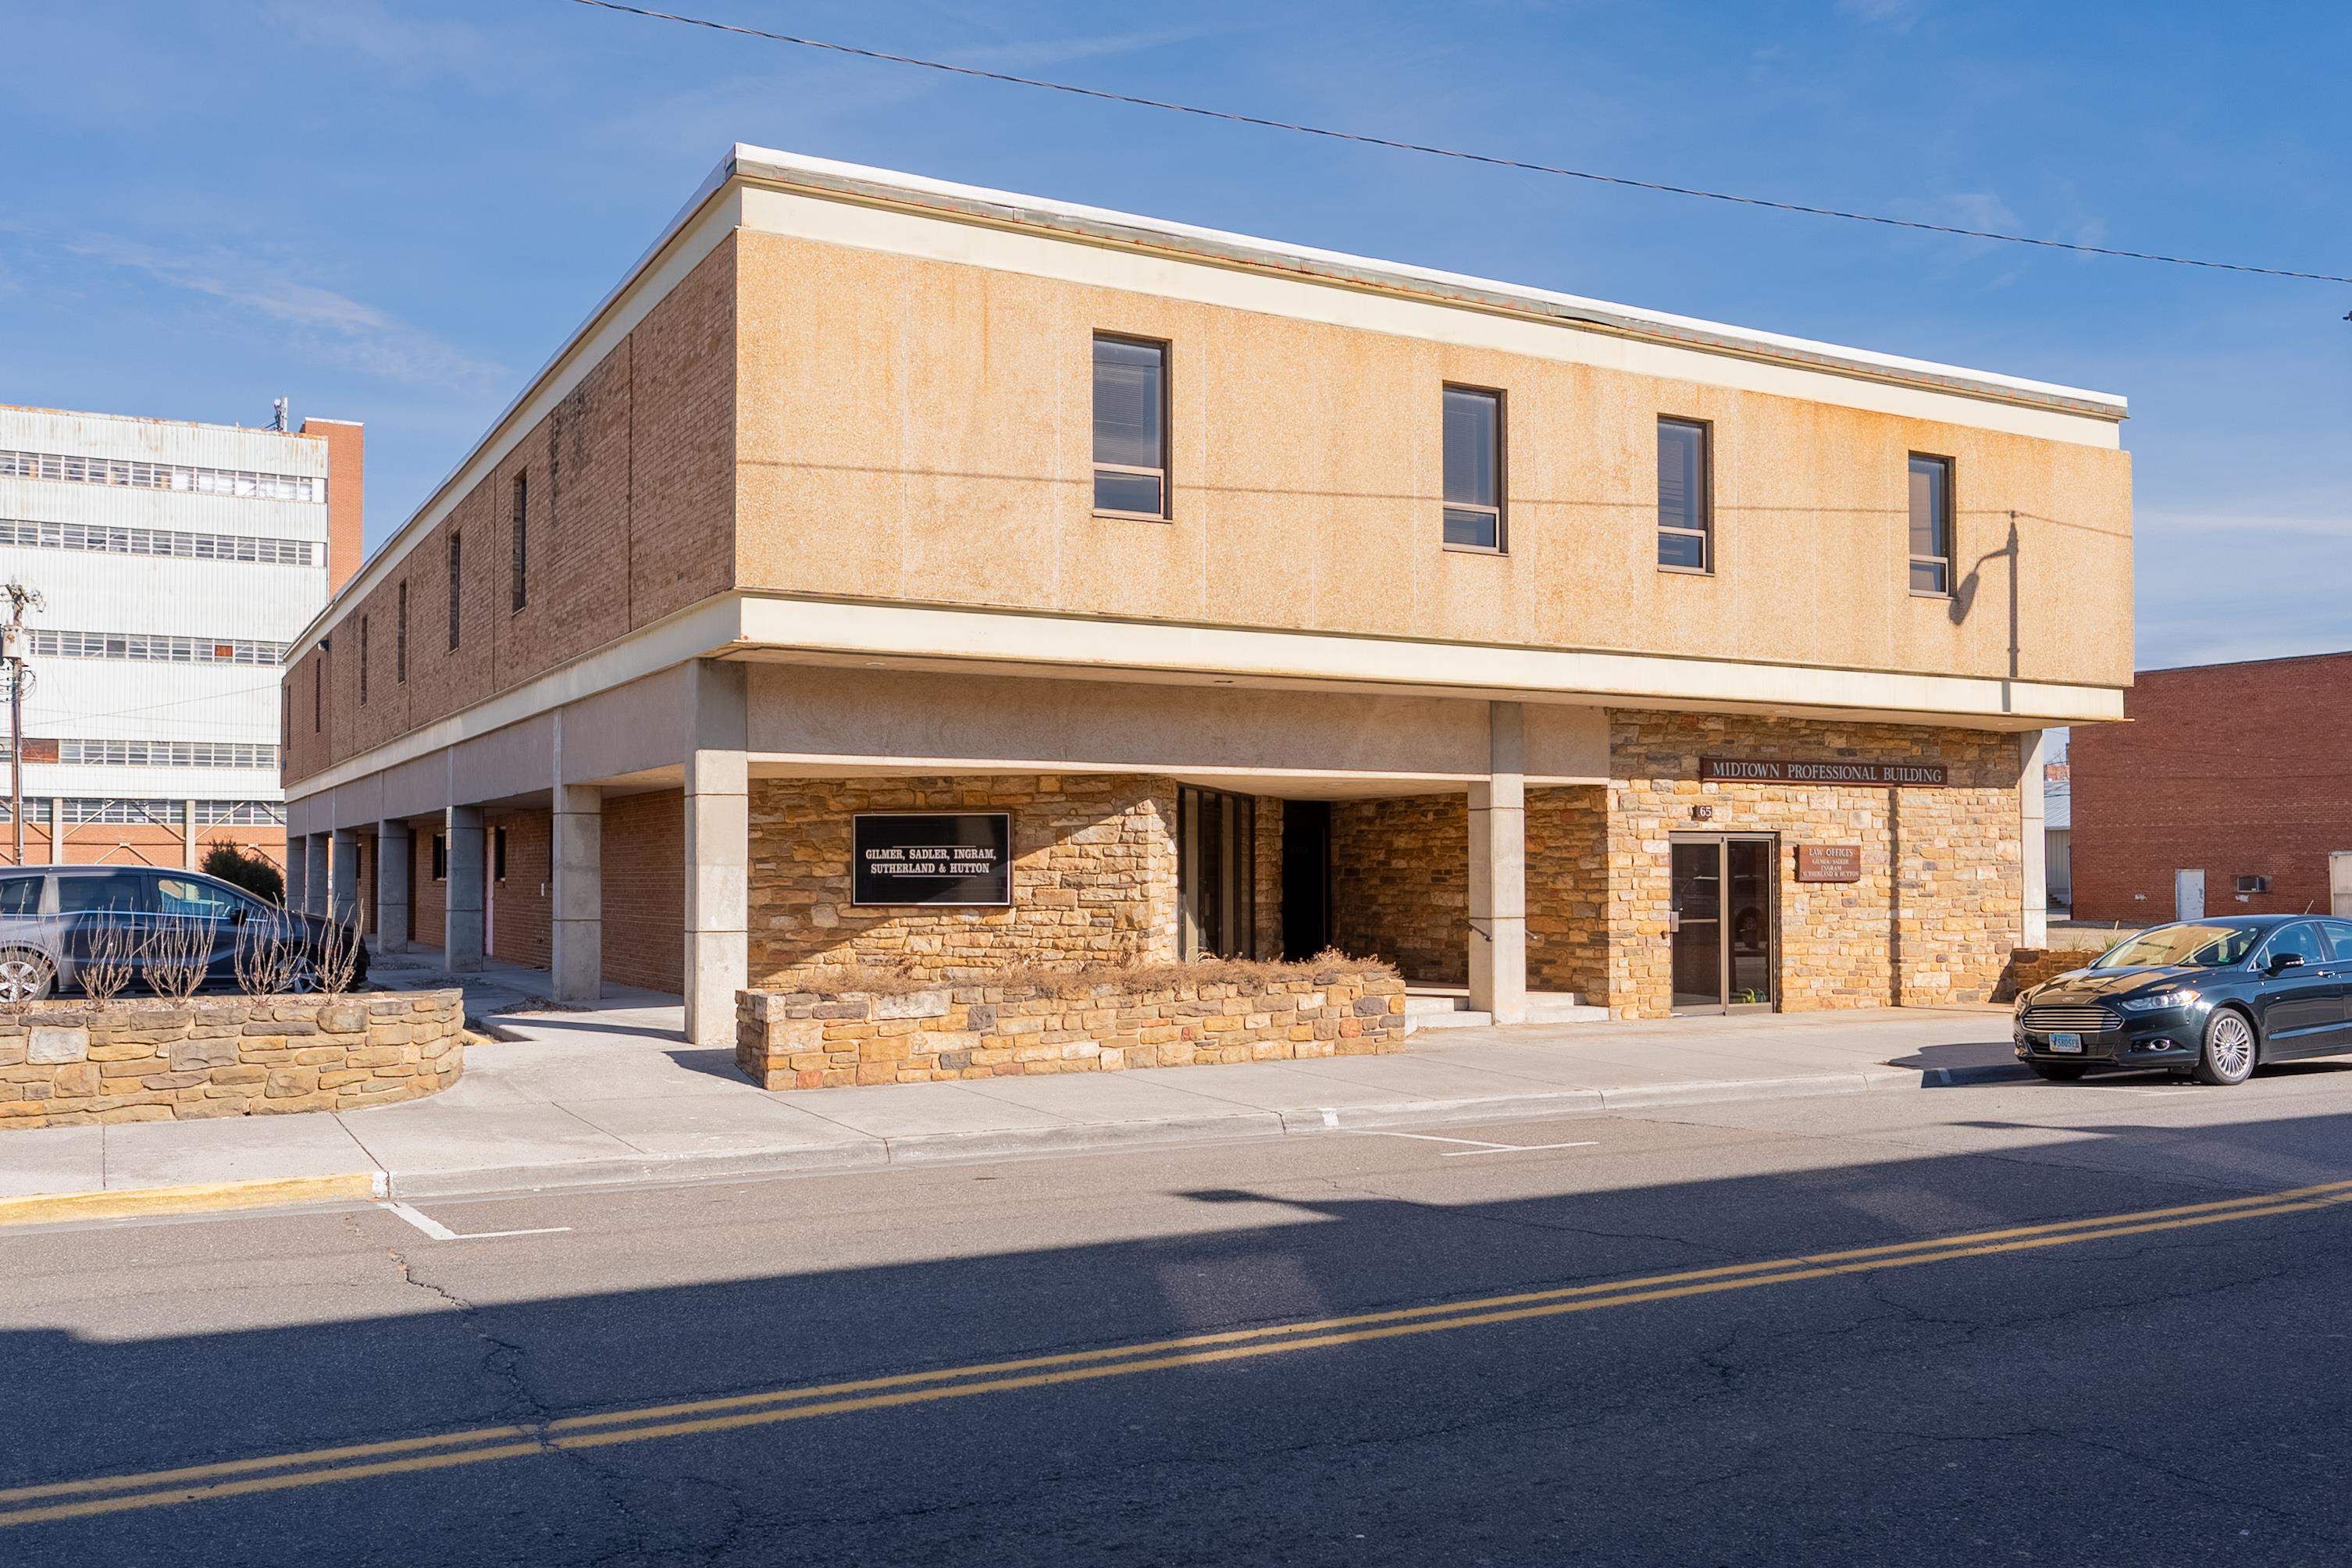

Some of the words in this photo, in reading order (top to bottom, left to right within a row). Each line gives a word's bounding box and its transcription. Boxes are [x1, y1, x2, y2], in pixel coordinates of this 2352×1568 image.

[1712, 761, 1780, 778] MIDTOWN
[1787, 764, 1877, 781] PROFESSIONAL
[1883, 767, 1942, 782] BUILDING
[1699, 806, 1712, 817] 65
[865, 849, 906, 861] GILMER,
[909, 849, 950, 861] SADLER,
[953, 848, 996, 861] INGRAM,
[1809, 848, 1823, 857] LAW
[1826, 848, 1853, 857] OFFICES
[871, 863, 935, 874] SUTHERLAND
[939, 863, 946, 874] &
[950, 863, 990, 874] HUTTON
